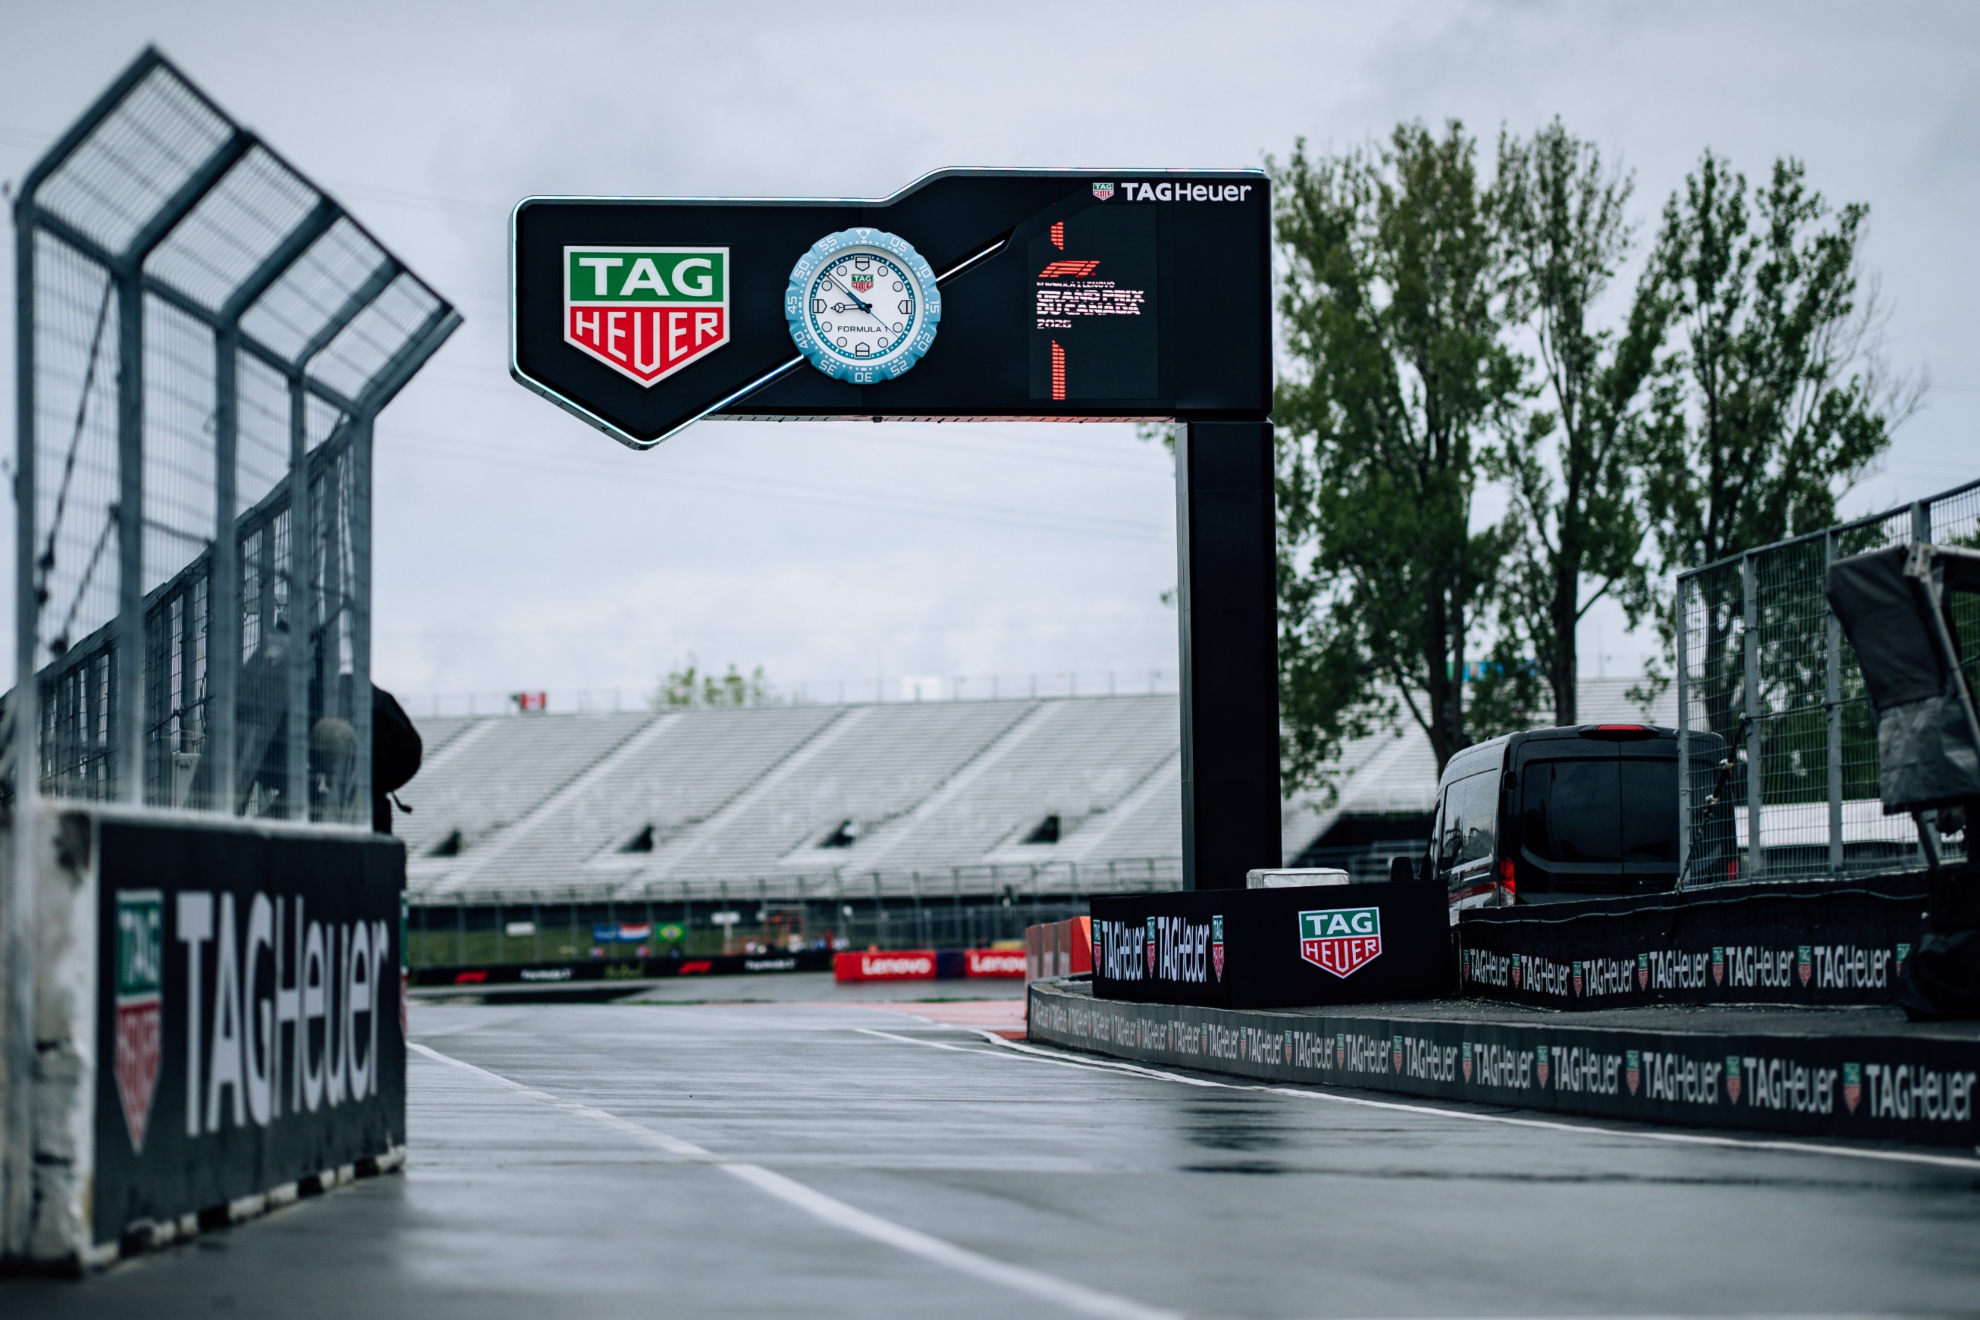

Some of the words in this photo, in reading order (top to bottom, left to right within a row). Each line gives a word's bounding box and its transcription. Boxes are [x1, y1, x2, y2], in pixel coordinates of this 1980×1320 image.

[818, 236, 837, 251] 55
[890, 237, 908, 252] 05
[794, 260, 810, 278] 50
[919, 263, 932, 279] 10
[579, 258, 713, 297] TAG
[853, 283, 873, 292] HEUER
[1037, 290, 1101, 302] GRAND
[1102, 290, 1145, 302] PRIX
[787, 296, 798, 315] 45
[931, 300, 939, 314] 15
[1037, 302, 1062, 315] DU
[1064, 302, 1141, 315] CANADA
[1037, 319, 1072, 329] 2026
[576, 311, 718, 375] HEUER
[793, 331, 809, 349] 40
[918, 333, 933, 352] 20
[819, 359, 838, 375] 35
[890, 360, 908, 376] 25
[854, 372, 873, 382] 30
[1305, 912, 1373, 936] TAG
[1305, 939, 1377, 973] HEUER
[862, 956, 931, 976] Lenovo
